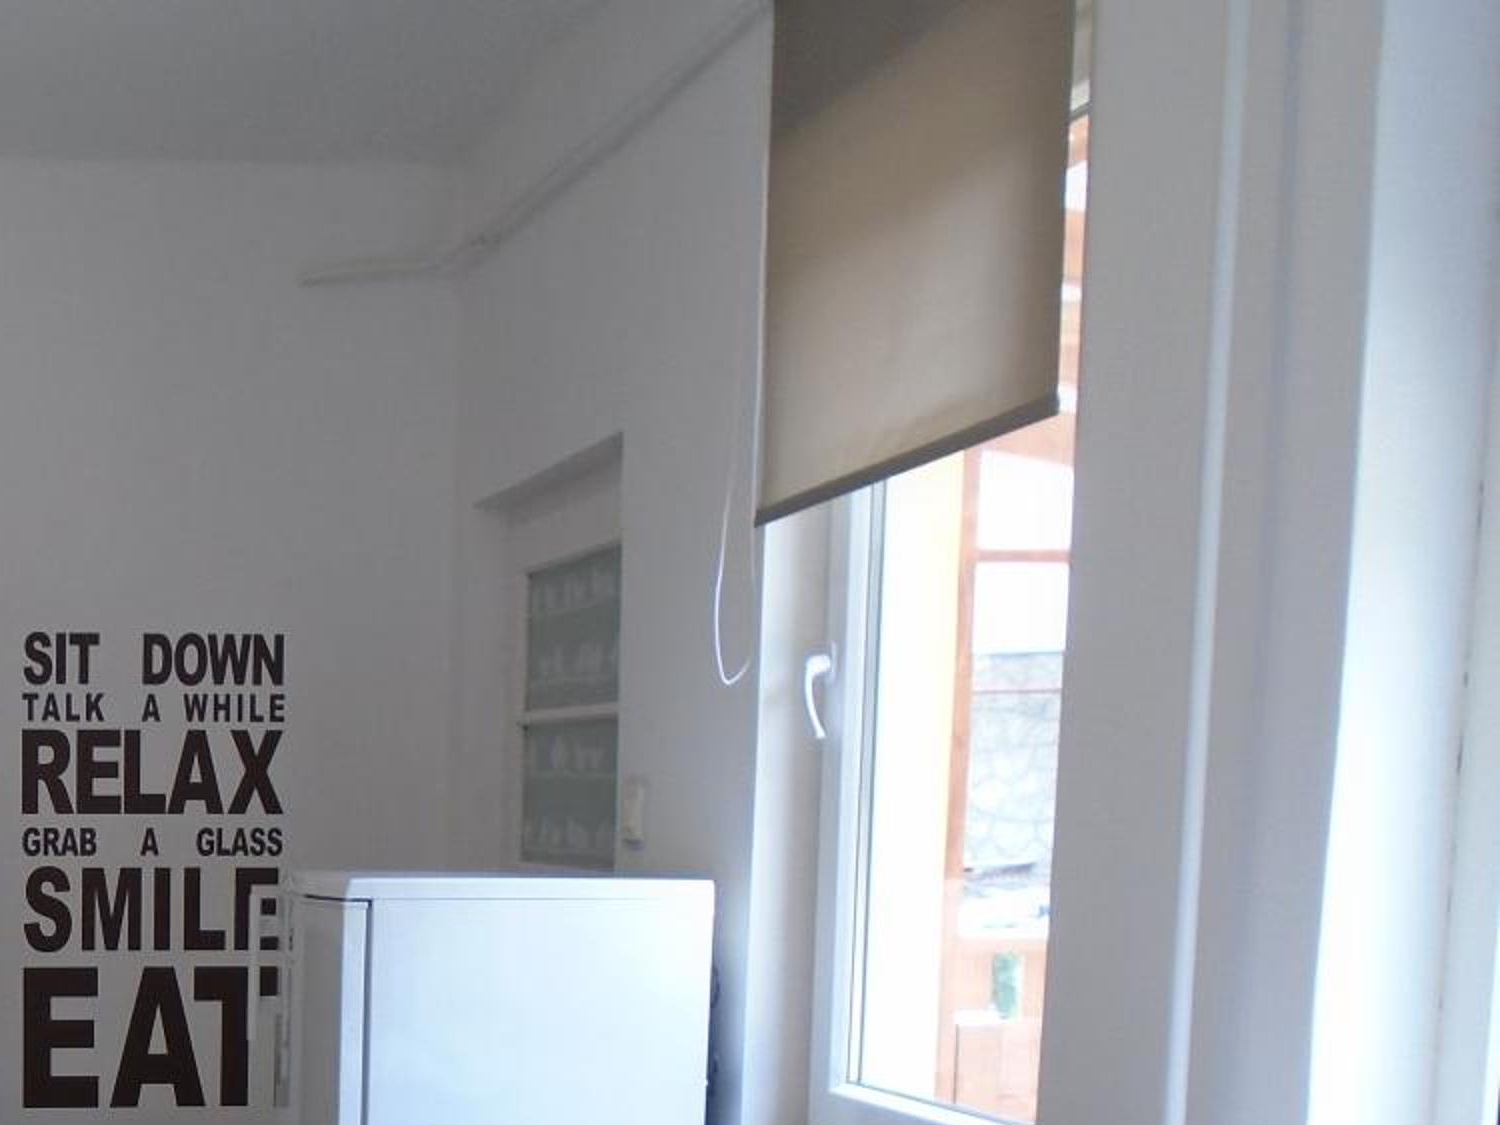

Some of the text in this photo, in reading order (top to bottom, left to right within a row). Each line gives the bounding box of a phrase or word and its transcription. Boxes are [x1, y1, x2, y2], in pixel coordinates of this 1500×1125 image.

[24, 632, 284, 686] SIT DOWN
[22, 693, 285, 722] TALK A WHILE
[22, 729, 283, 815] RELAX
[22, 828, 282, 856] GRAB A GLASS
[24, 866, 280, 952] SMILE
[23, 966, 280, 1108] EAT
